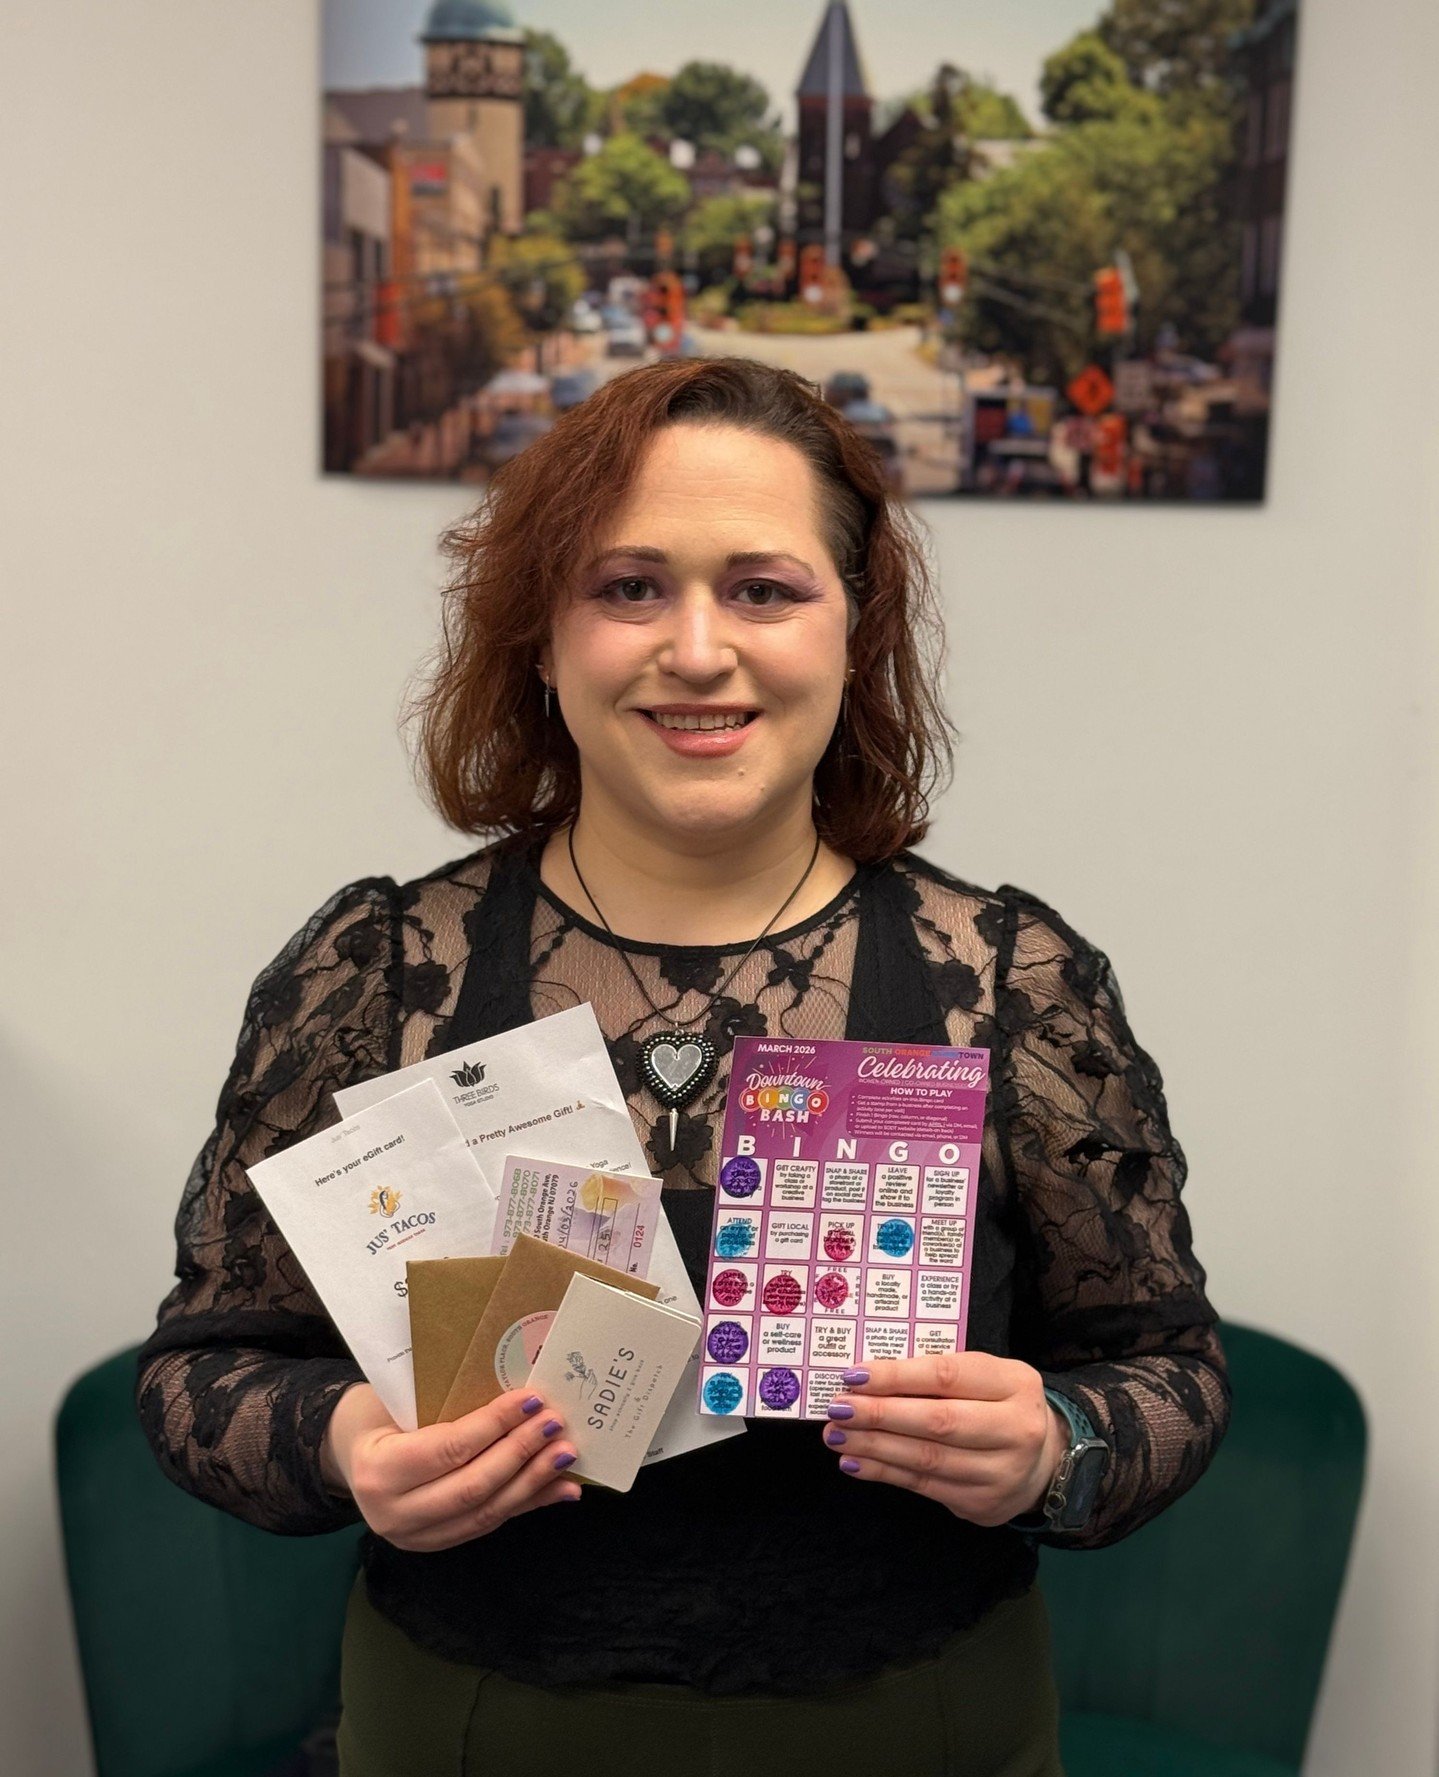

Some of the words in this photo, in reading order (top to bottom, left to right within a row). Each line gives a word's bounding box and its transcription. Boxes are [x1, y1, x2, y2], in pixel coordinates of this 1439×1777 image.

[757, 1044, 792, 1054] MARCH
[794, 1046, 816, 1054] 2026
[862, 1047, 892, 1055] SOUTH
[894, 1049, 932, 1057] ORANGE
[857, 1056, 986, 1088] Celebrating
[746, 1072, 827, 1090] Downtown
[452, 1092, 476, 1104] THREE
[476, 1084, 500, 1098] BIRDS
[746, 1092, 822, 1108] BINGO
[890, 1088, 913, 1096] HOW
[916, 1088, 928, 1096] TO
[930, 1089, 953, 1098] PLAY
[760, 1109, 810, 1124] BASH
[472, 1138, 478, 1146] a
[479, 1128, 506, 1144] Pretty
[508, 1114, 552, 1134] Awesome
[553, 1105, 574, 1119] Gift!
[314, 1170, 342, 1187] Here's
[342, 1158, 362, 1174] your
[362, 1146, 384, 1162] eGift
[384, 1134, 406, 1151] card!
[590, 1158, 608, 1169] Yoga
[776, 1164, 789, 1172] GET
[951, 1170, 960, 1178] UP
[550, 1174, 560, 1196] 07079
[503, 1168, 522, 1237] 973-877-8068
[524, 1171, 540, 1232] 73-877-8071
[538, 1187, 550, 1214] Orange
[549, 1194, 557, 1204] NJ
[536, 1213, 545, 1234] South
[545, 1204, 556, 1229] Orange
[366, 1229, 390, 1256] JUS'
[391, 1211, 436, 1235] TACOS
[634, 1225, 645, 1248] 0124
[770, 1330, 802, 1338] self-care
[814, 1326, 828, 1334] TRY
[772, 1338, 802, 1346] wellness
[826, 1336, 846, 1344] great
[767, 1346, 796, 1354] product
[812, 1350, 850, 1359] accessory
[588, 1347, 635, 1430] SADIE'S
[625, 1425, 634, 1438] The
[634, 1404, 646, 1421] Gift
[643, 1364, 663, 1401] Dispatch
